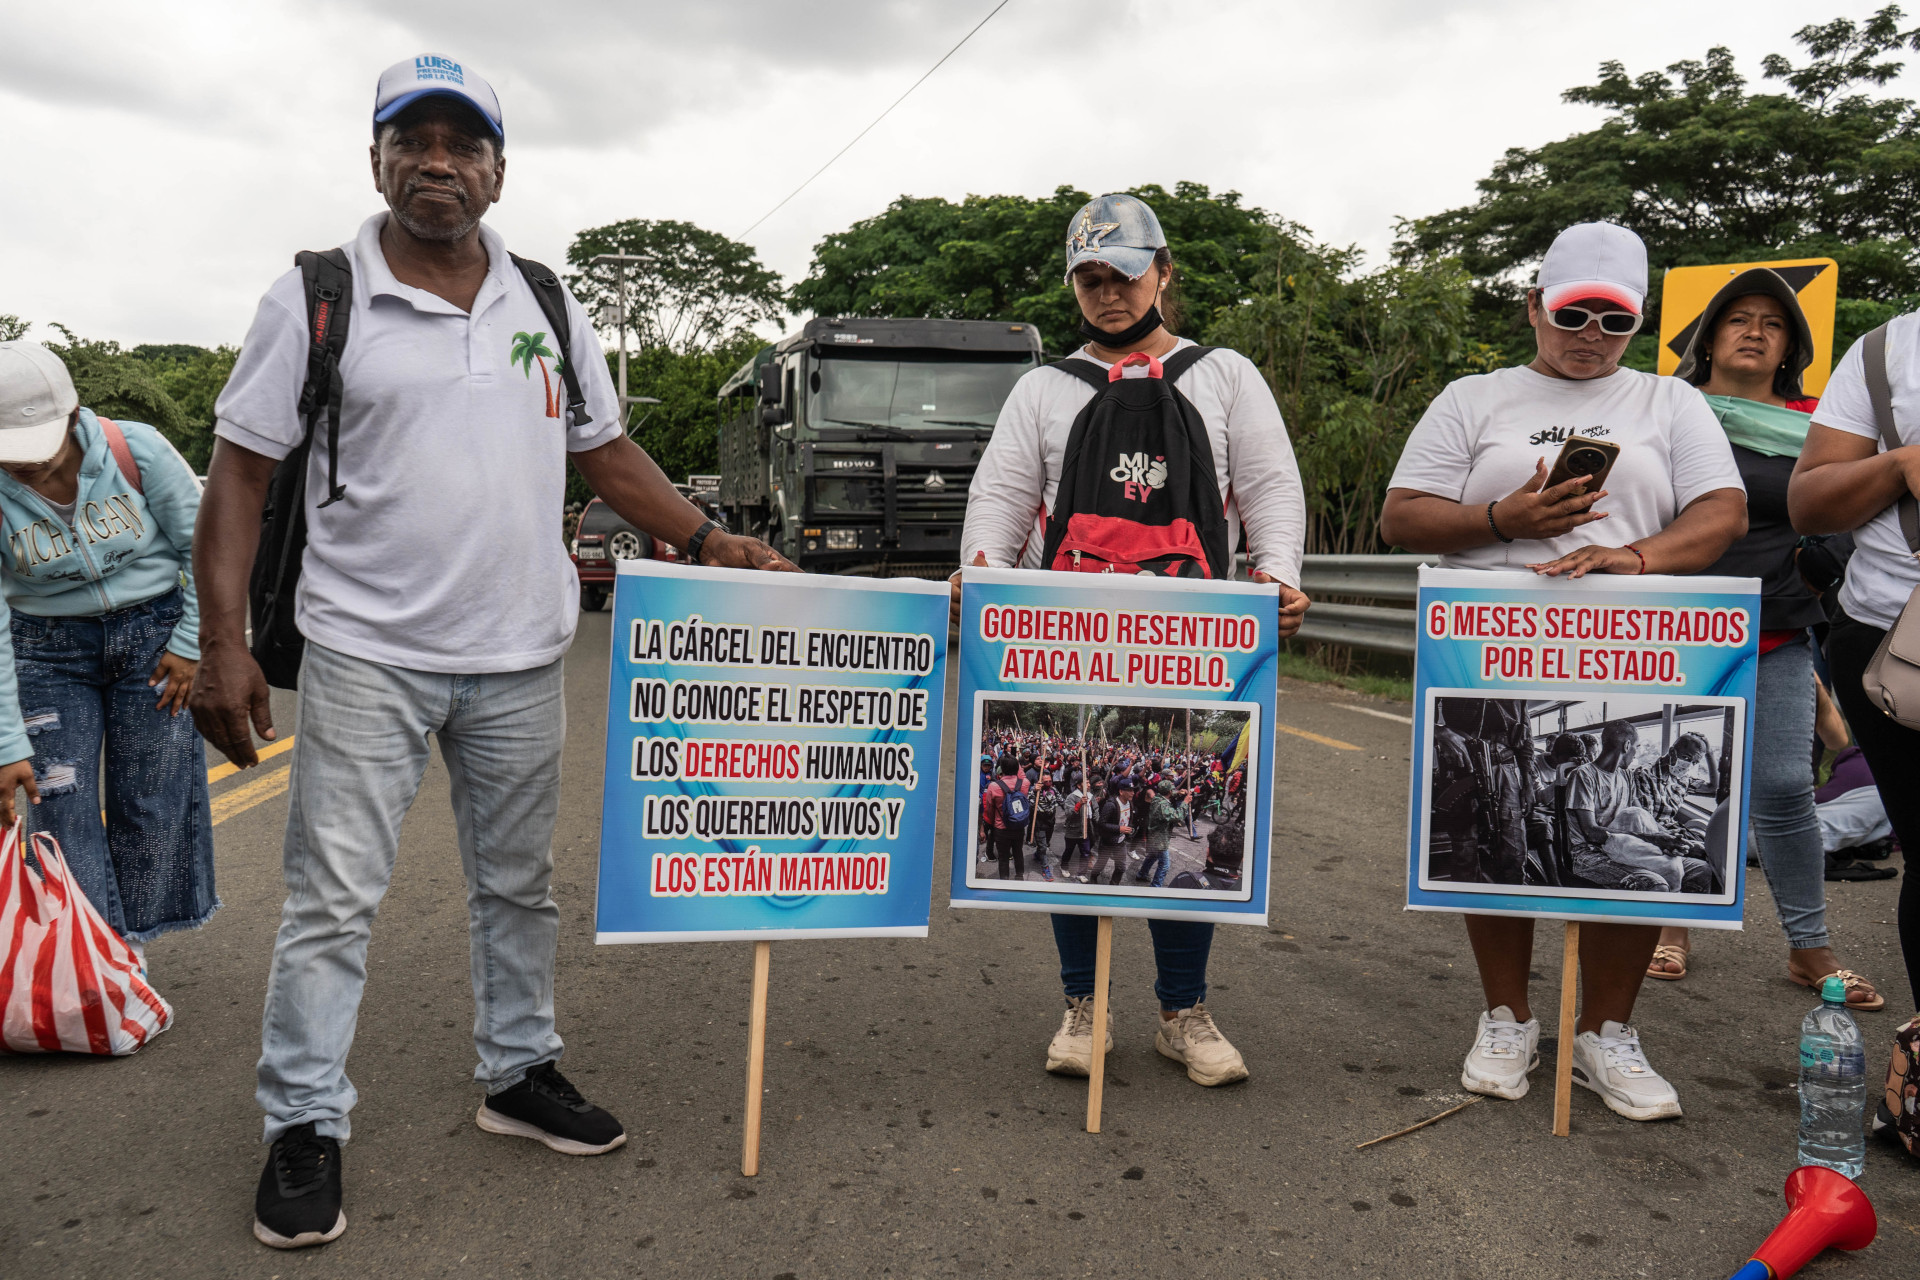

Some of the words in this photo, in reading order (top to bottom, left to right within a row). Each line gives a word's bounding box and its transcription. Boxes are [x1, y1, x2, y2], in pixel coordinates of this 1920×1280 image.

[833, 460, 875, 469] HOWO
[984, 607, 1109, 643] GOBIERNO
[1116, 613, 1256, 650] RESENTIDO
[1430, 604, 1447, 636] 6
[1454, 605, 1538, 638] MESES
[1545, 607, 1745, 644] SECUESTRADOS
[634, 622, 663, 661] LA
[670, 619, 754, 664] CÁRCEL
[761, 629, 801, 667] DEL
[807, 633, 931, 672] ENCUENTRO
[1485, 646, 1533, 678] POR
[1541, 647, 1570, 679] EL
[1578, 649, 1682, 683] ESTADO.
[1003, 648, 1086, 681] ATACA
[1088, 652, 1121, 683] AL
[1128, 653, 1231, 688] PUEBLO.
[634, 682, 666, 719] NO
[672, 683, 761, 721] CONOCE
[767, 687, 792, 723] EL
[798, 688, 892, 726] RESPETO
[897, 692, 924, 727] DE
[636, 741, 679, 777] LOS
[685, 742, 800, 779] DERECHOS
[806, 744, 914, 786] HUMANOS,
[647, 799, 690, 835] LOS
[696, 799, 816, 838] QUEREMOS
[820, 801, 880, 836] VIVOS
[885, 801, 901, 836] Y
[655, 856, 697, 893] LOS
[703, 850, 773, 893] ESTÁN
[779, 856, 887, 892] MATANDO!
